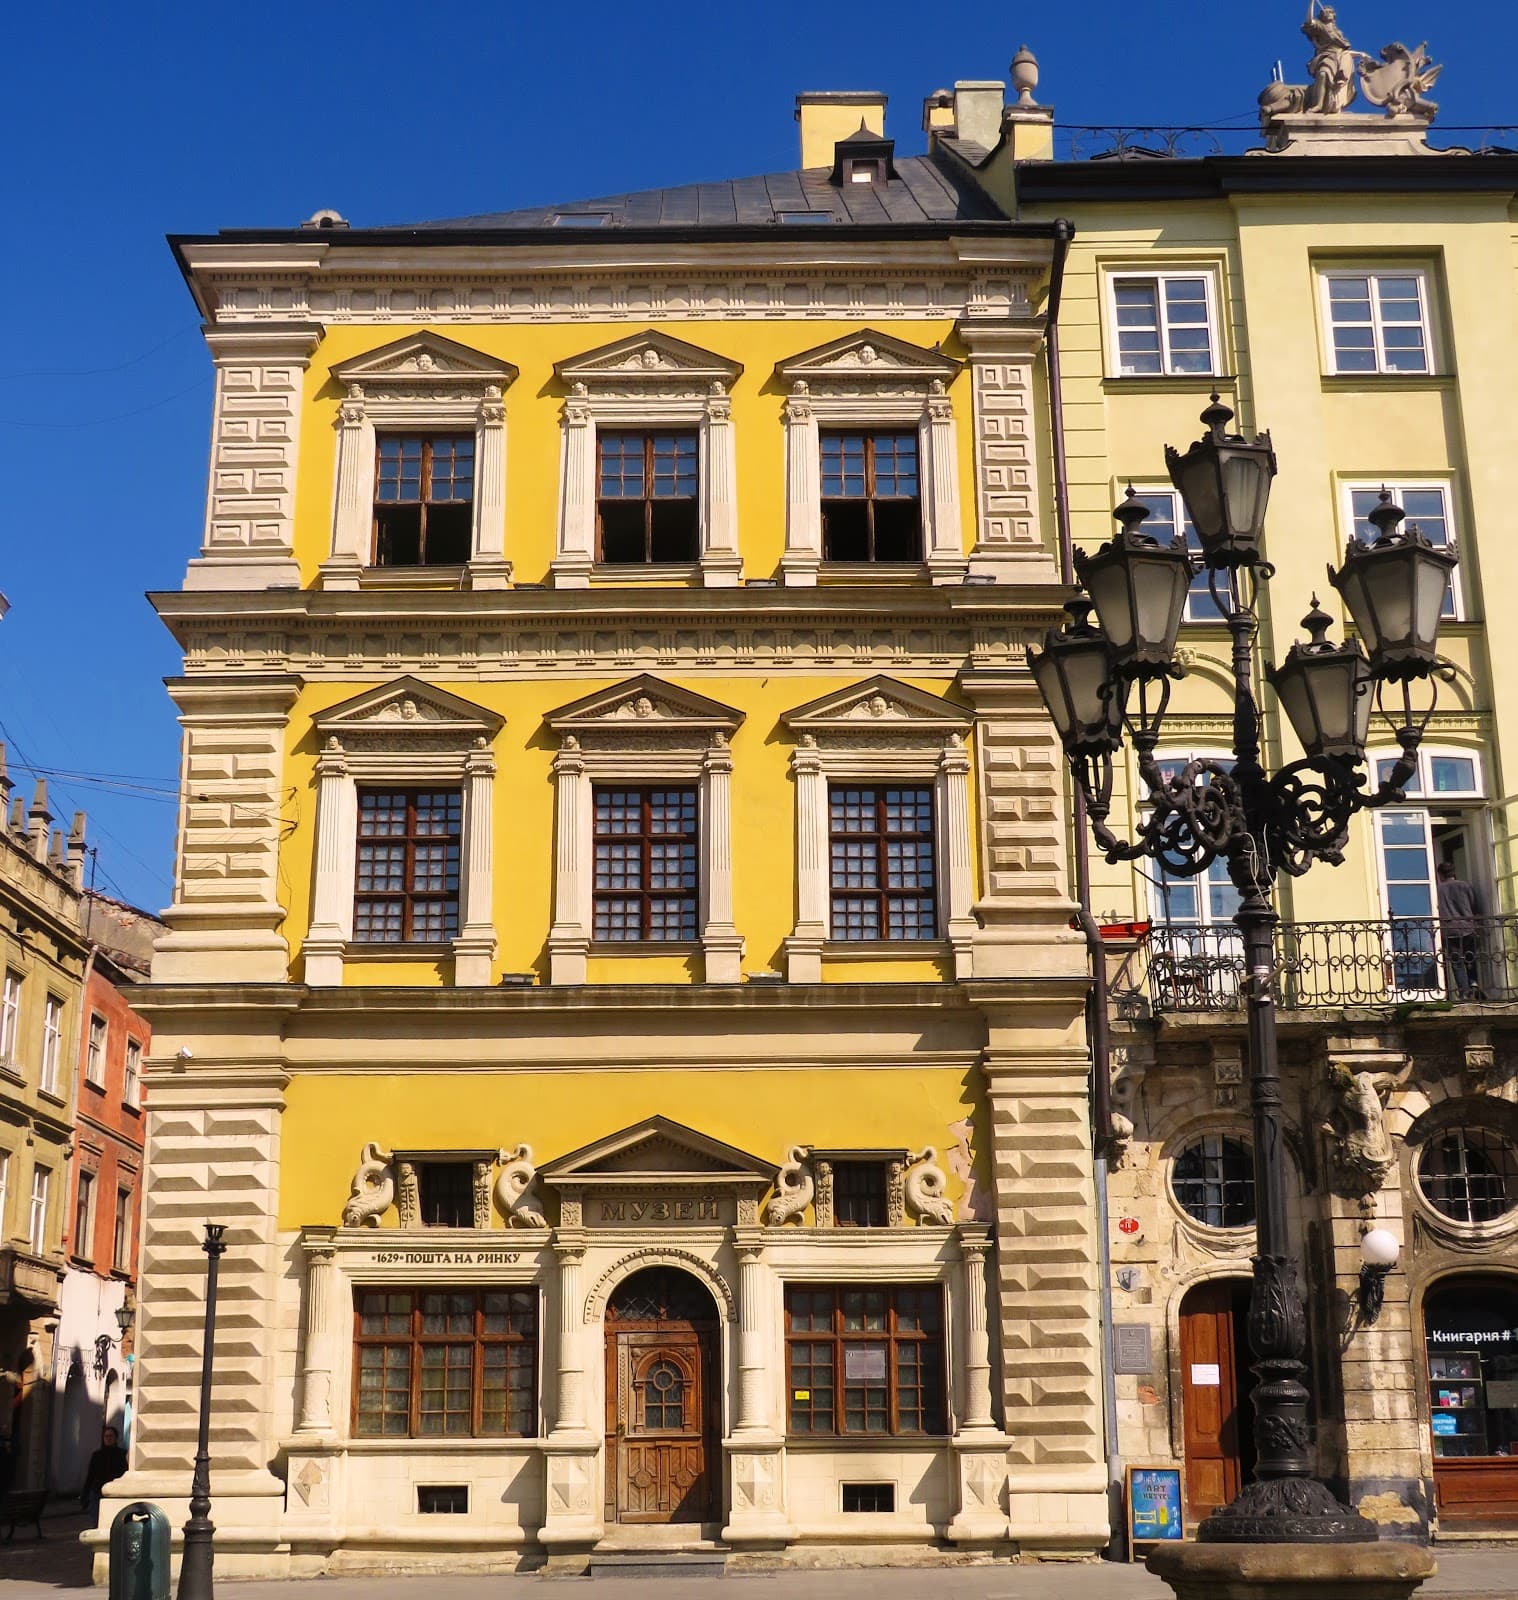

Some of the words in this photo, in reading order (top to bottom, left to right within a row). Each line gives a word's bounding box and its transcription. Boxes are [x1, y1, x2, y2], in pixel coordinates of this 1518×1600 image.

[600, 1195, 719, 1221] МУЗЕЙ
[405, 1253, 452, 1264] ПОШТА
[454, 1253, 473, 1264] НА
[477, 1253, 521, 1264] РИНКУ
[1432, 1330, 1500, 1345] Книгарня
